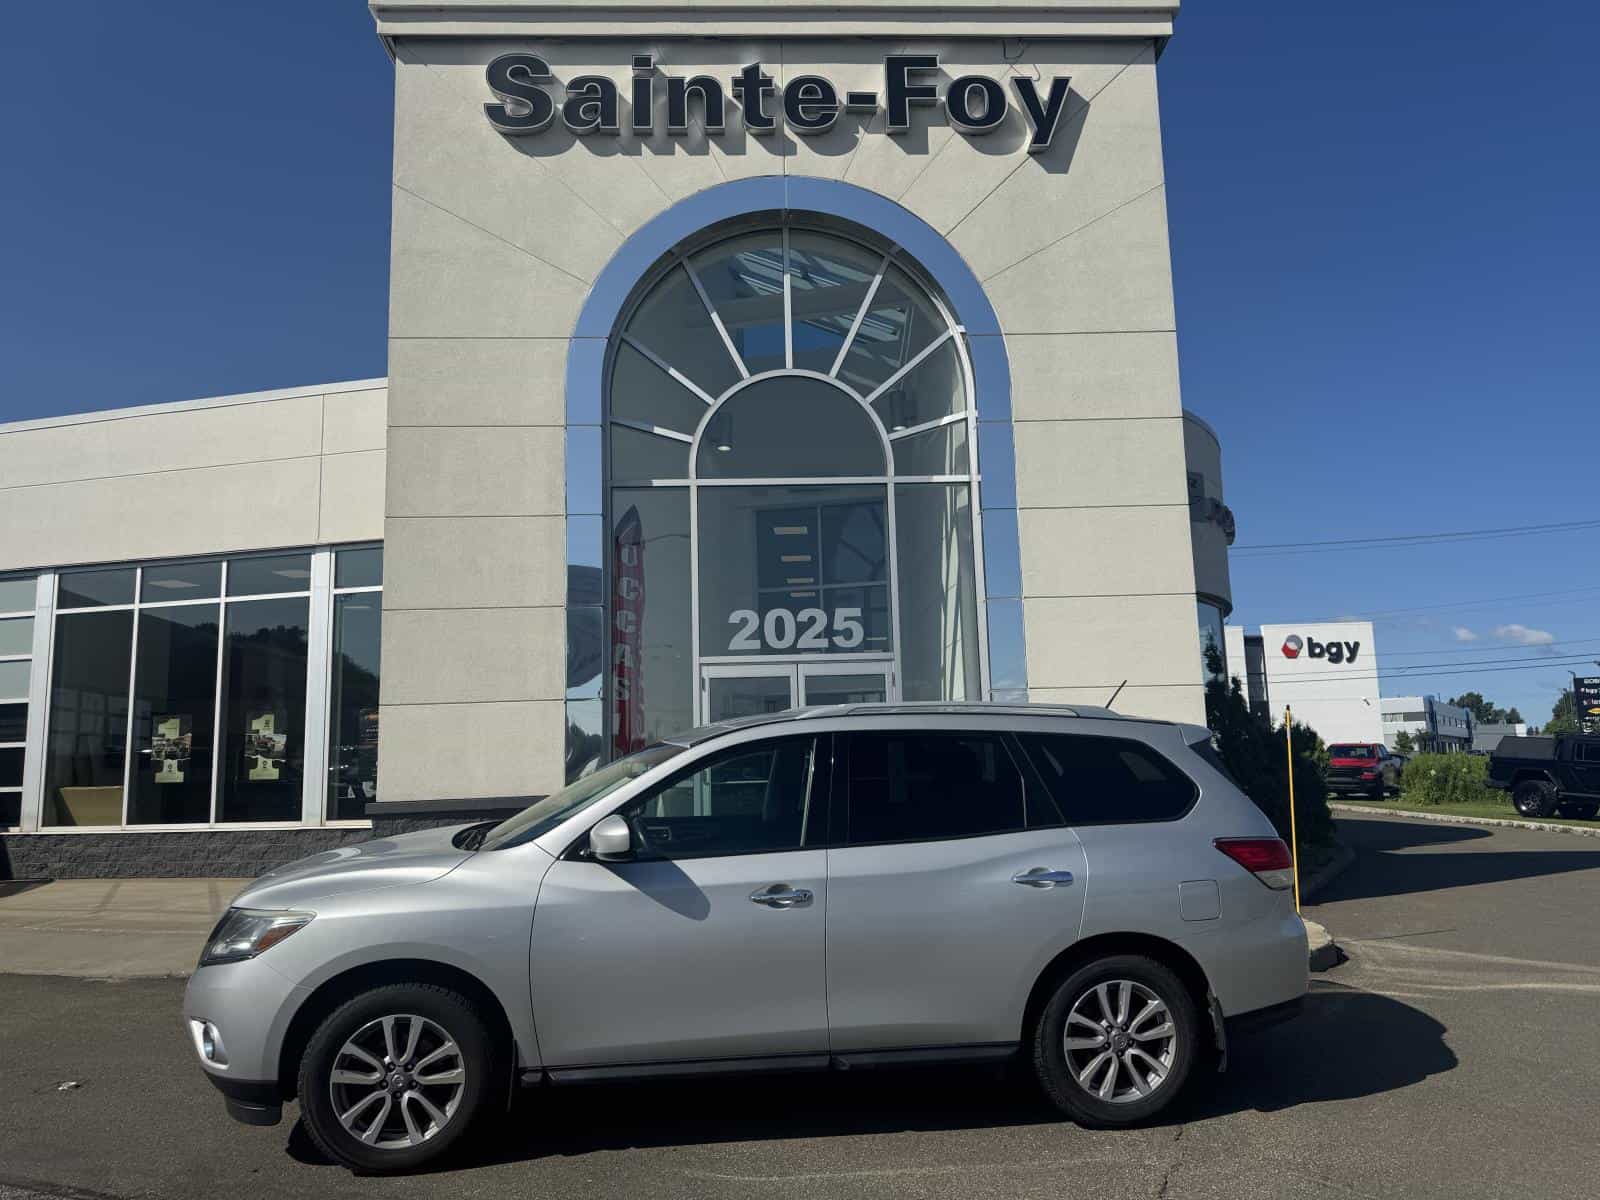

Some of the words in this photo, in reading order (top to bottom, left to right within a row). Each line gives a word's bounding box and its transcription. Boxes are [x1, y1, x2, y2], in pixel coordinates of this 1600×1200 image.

[484, 53, 1071, 153] Sainte-Foy
[727, 607, 865, 650] 2025
[1306, 636, 1361, 664] bgy
